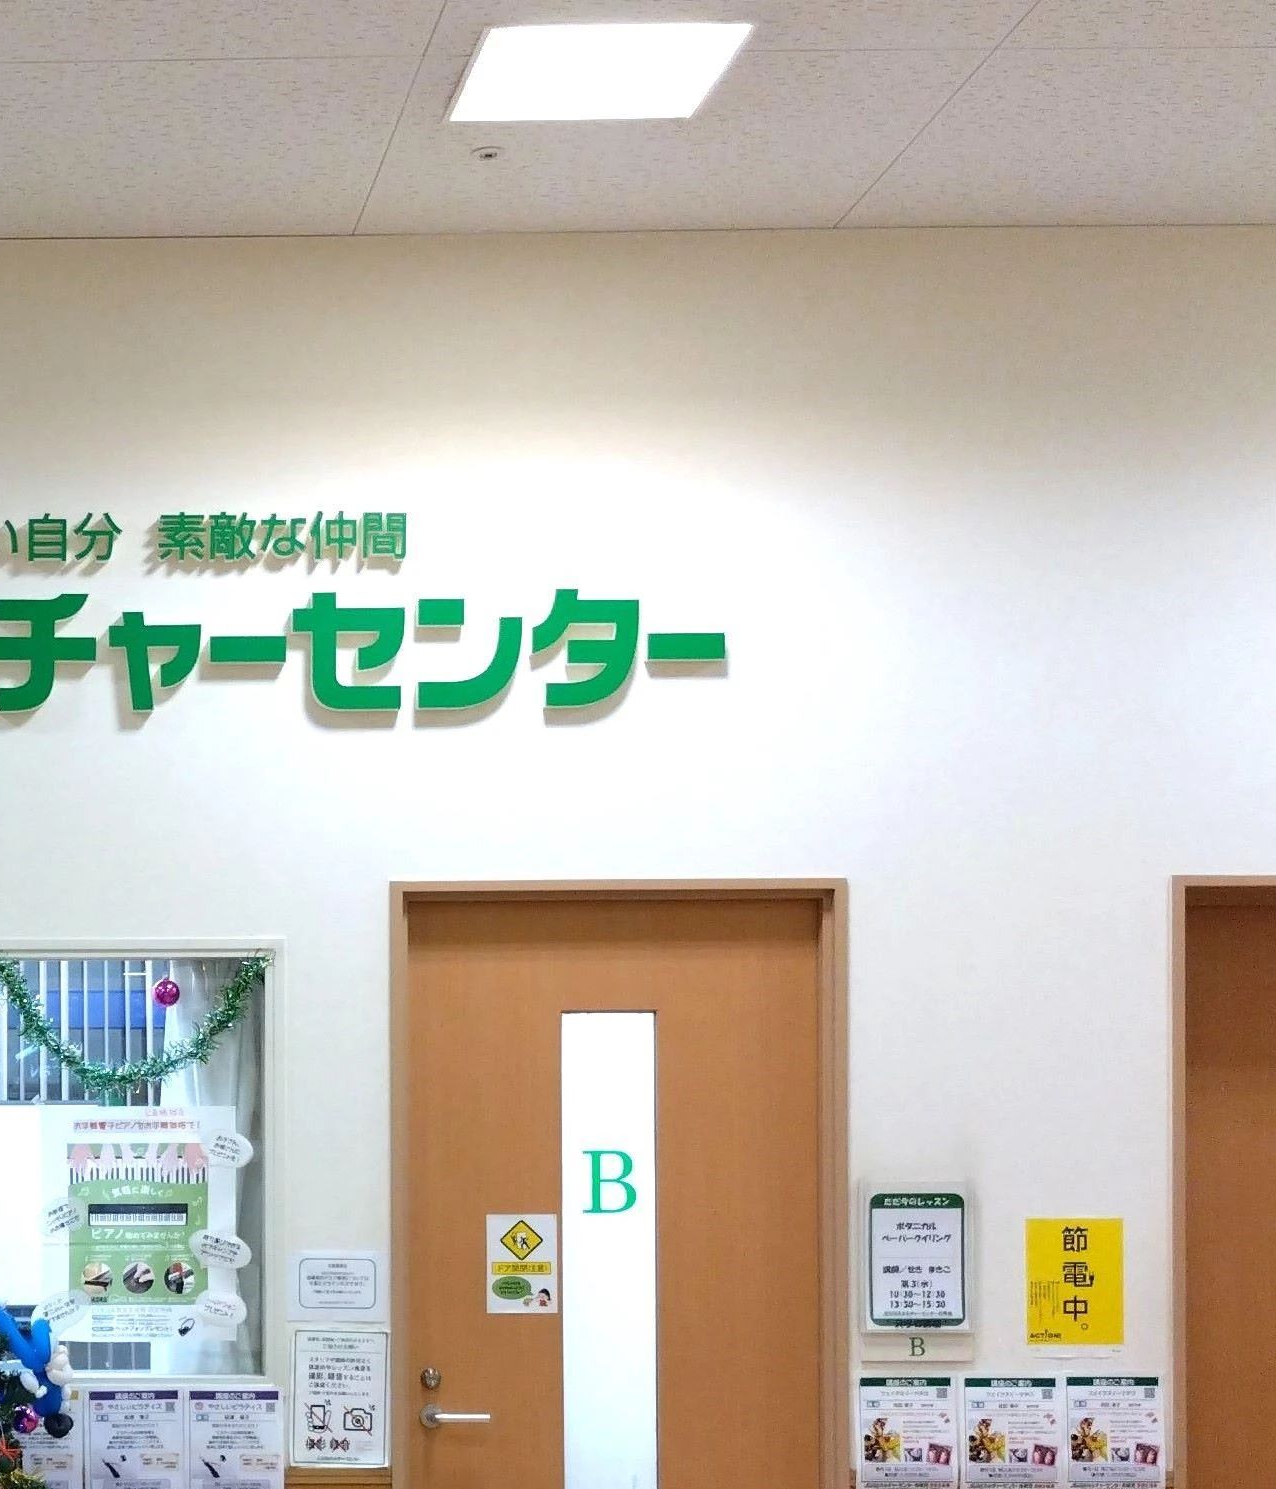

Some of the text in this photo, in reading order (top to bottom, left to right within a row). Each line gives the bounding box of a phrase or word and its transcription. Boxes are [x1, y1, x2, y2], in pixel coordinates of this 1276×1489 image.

[158, 512, 407, 561] 素敵な仲間
[583, 1151, 636, 1213] B
[909, 1337, 926, 1357] B
